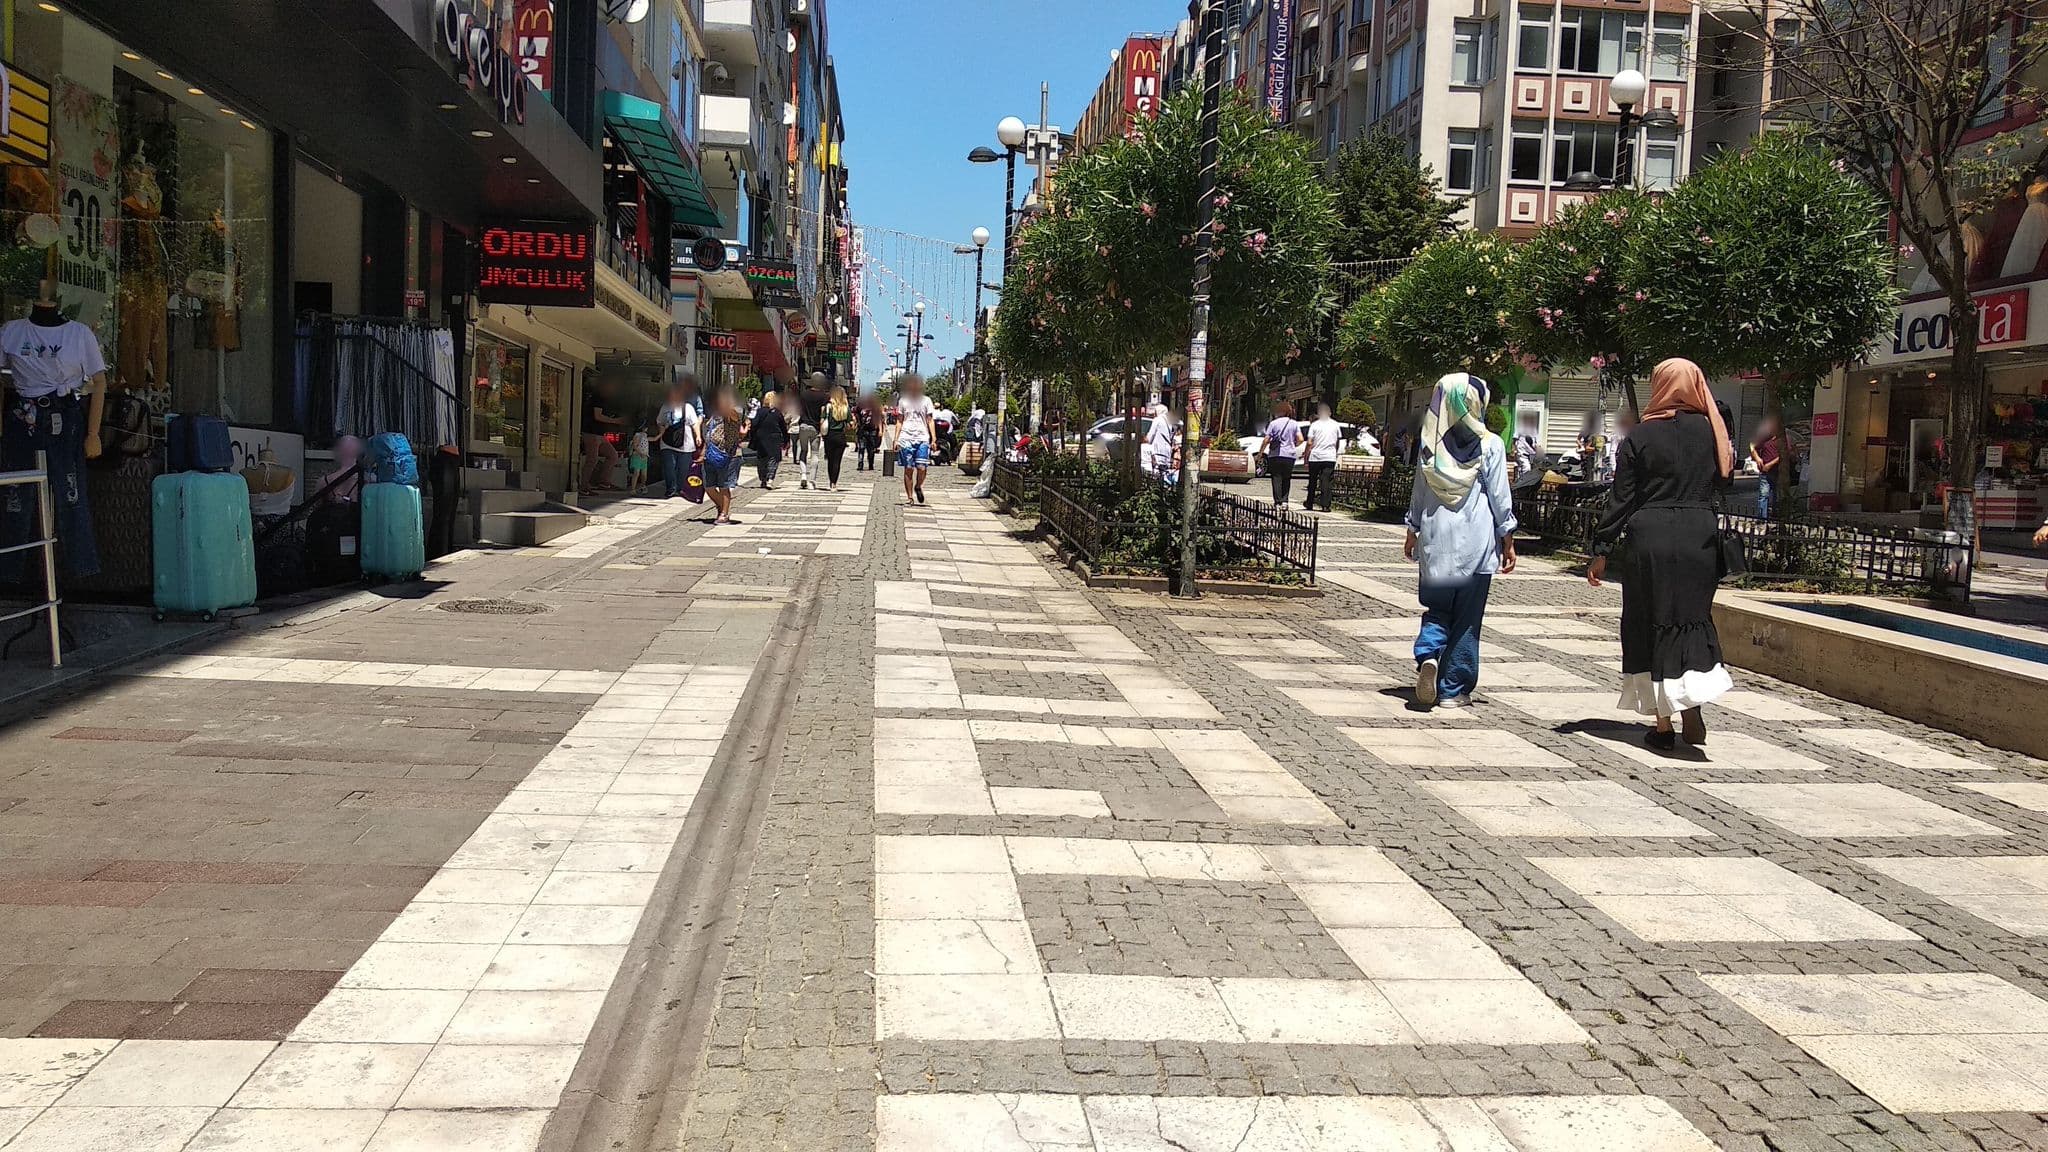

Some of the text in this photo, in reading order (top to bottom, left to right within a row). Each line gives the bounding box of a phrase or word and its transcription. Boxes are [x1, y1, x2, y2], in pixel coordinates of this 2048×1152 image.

[1272, 17, 1288, 61] KÜLTÜR
[67, 188, 100, 262] 30
[483, 228, 586, 259] ORDU
[58, 258, 107, 294] İNDİRİM
[748, 265, 795, 281] ÖZCAN
[1893, 298, 2012, 355] Leota
